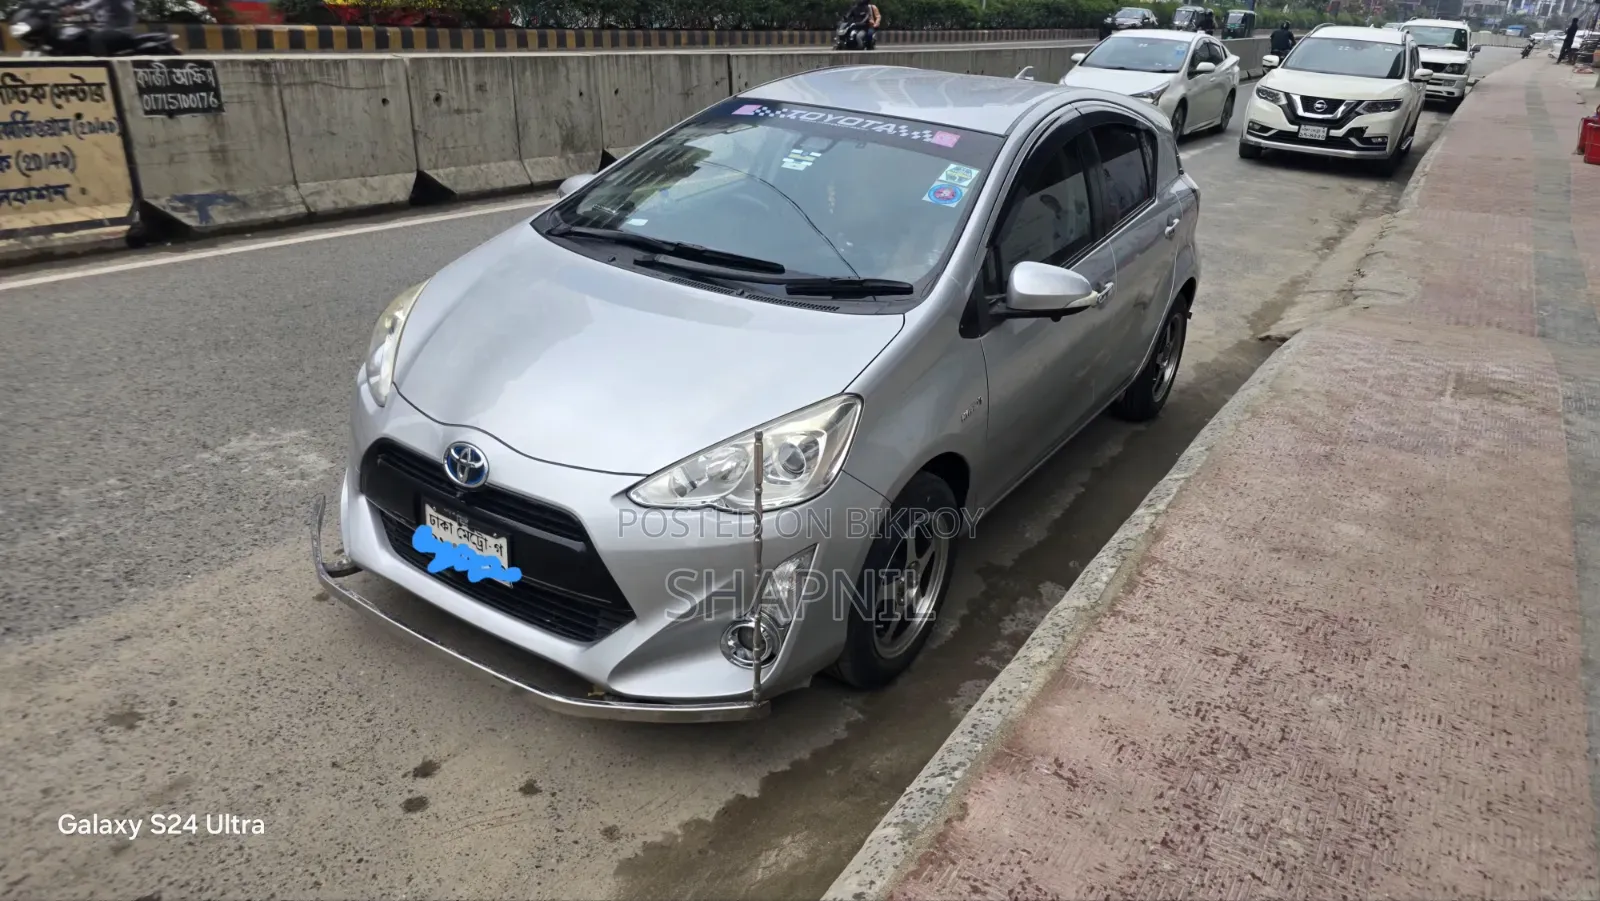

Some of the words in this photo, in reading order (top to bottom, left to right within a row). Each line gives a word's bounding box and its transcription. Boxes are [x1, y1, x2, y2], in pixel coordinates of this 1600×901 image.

[133, 62, 170, 88] কাজী
[171, 62, 216, 88] অফিস
[143, 92, 219, 111] 01715100176
[787, 109, 897, 135] TOYOTA
[429, 514, 453, 535] ঢাকা
